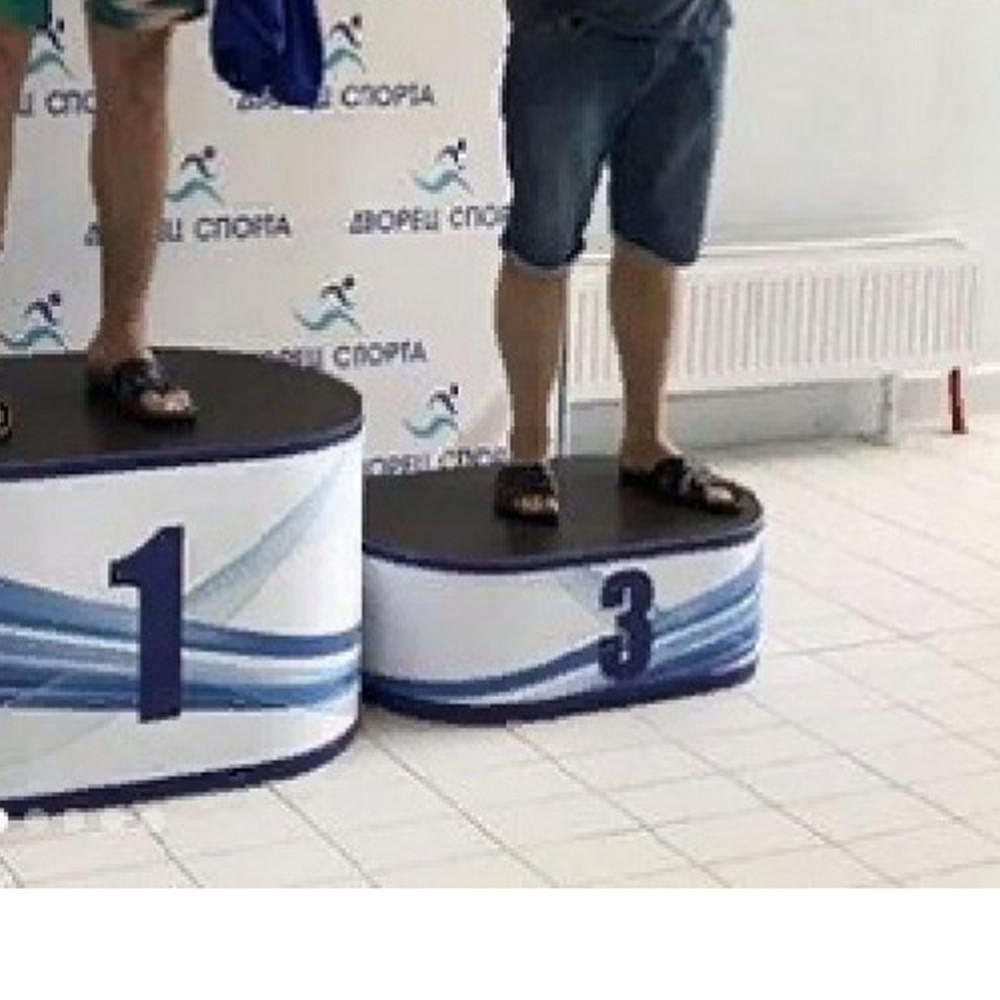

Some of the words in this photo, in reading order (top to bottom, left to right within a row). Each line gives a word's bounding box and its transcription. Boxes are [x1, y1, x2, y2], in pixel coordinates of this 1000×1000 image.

[46, 89, 96, 114] СПО
[340, 85, 436, 109] СПОРТА
[194, 214, 291, 242] СПОРТА
[348, 208, 439, 235] ДВОРЕЦ
[449, 205, 510, 231] СПОР
[333, 341, 427, 369] СПОРТА
[108, 525, 186, 722] 1
[599, 569, 653, 681] 3
